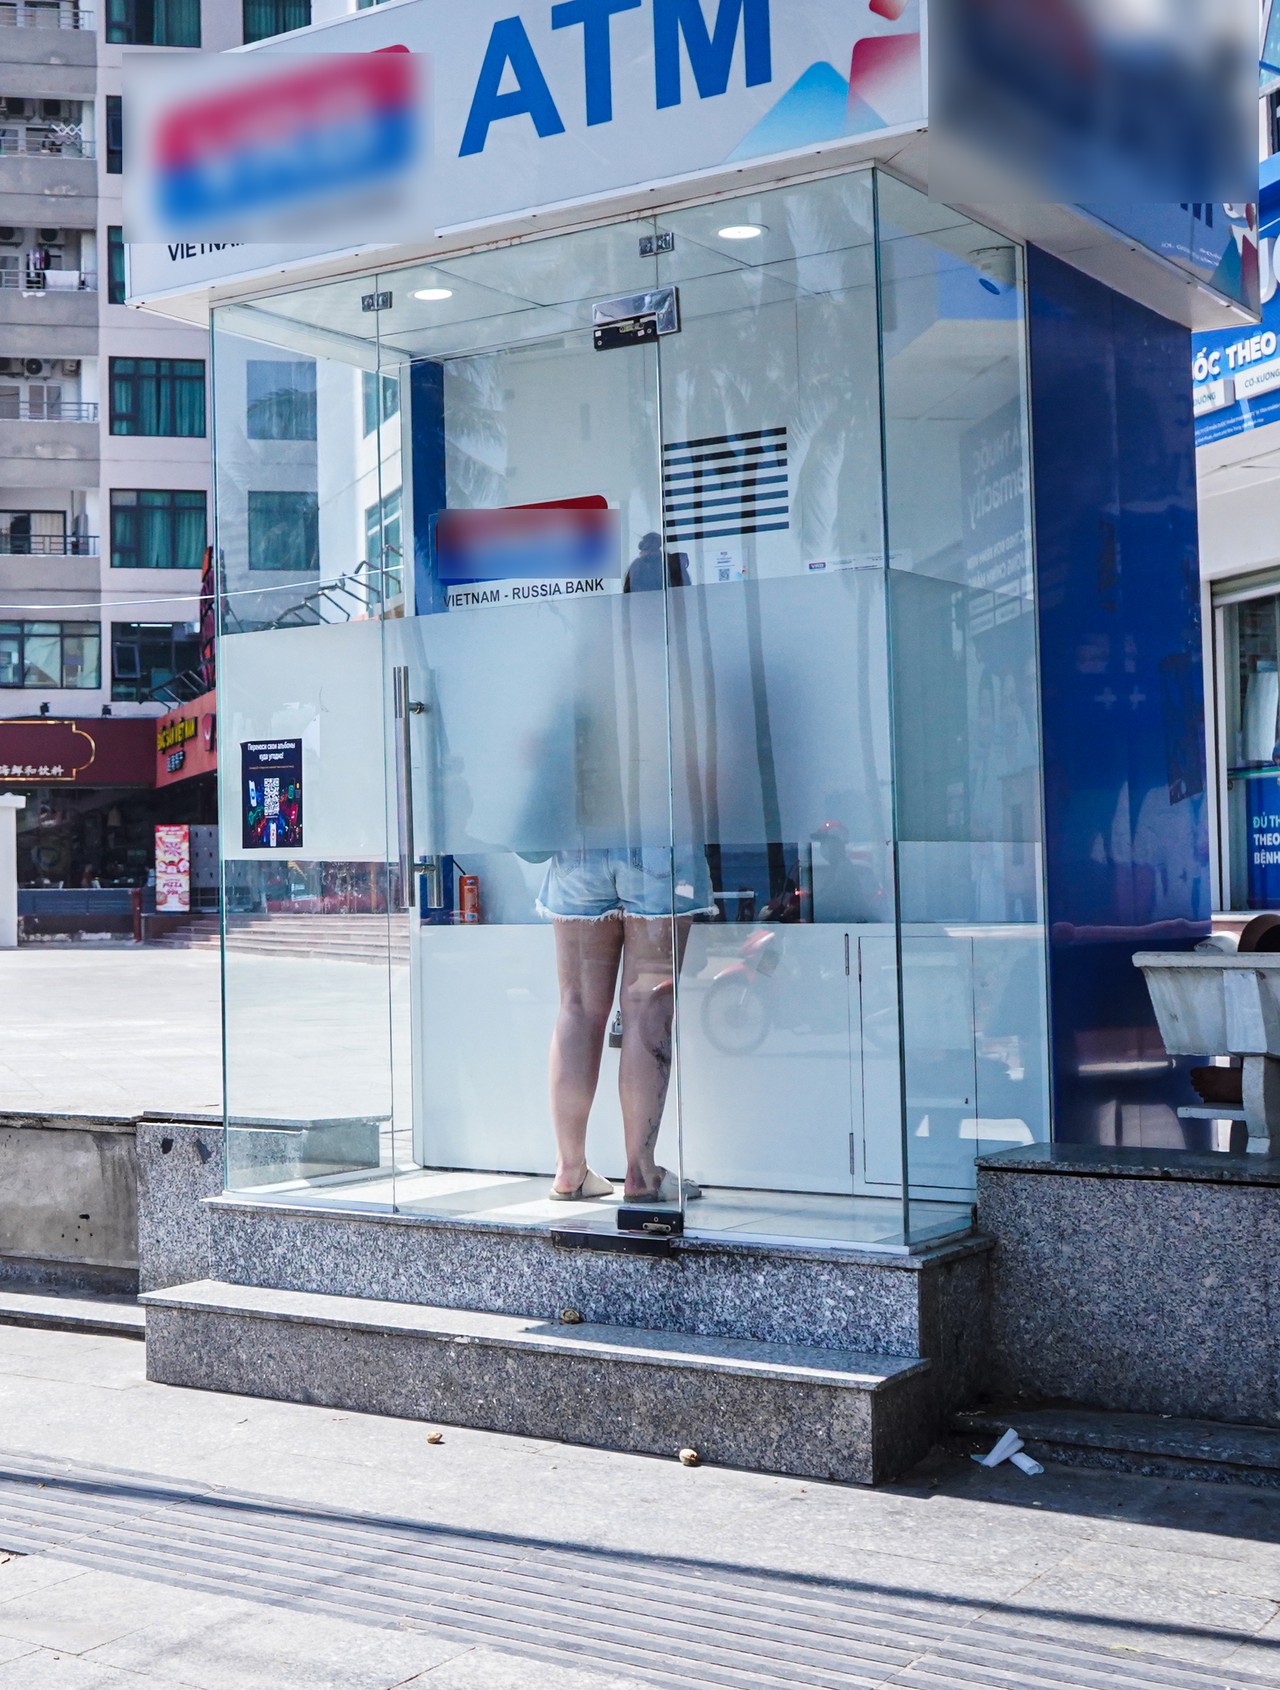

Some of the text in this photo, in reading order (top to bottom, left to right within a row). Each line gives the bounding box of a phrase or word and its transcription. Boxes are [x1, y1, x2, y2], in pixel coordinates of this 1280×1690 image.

[458, 0, 772, 158] ATM
[1225, 331, 1277, 369] THEO
[444, 590, 500, 608] VIETNAM
[512, 579, 562, 600] RUSSIA
[565, 577, 604, 595] BANK
[1254, 832, 1280, 846] THEO
